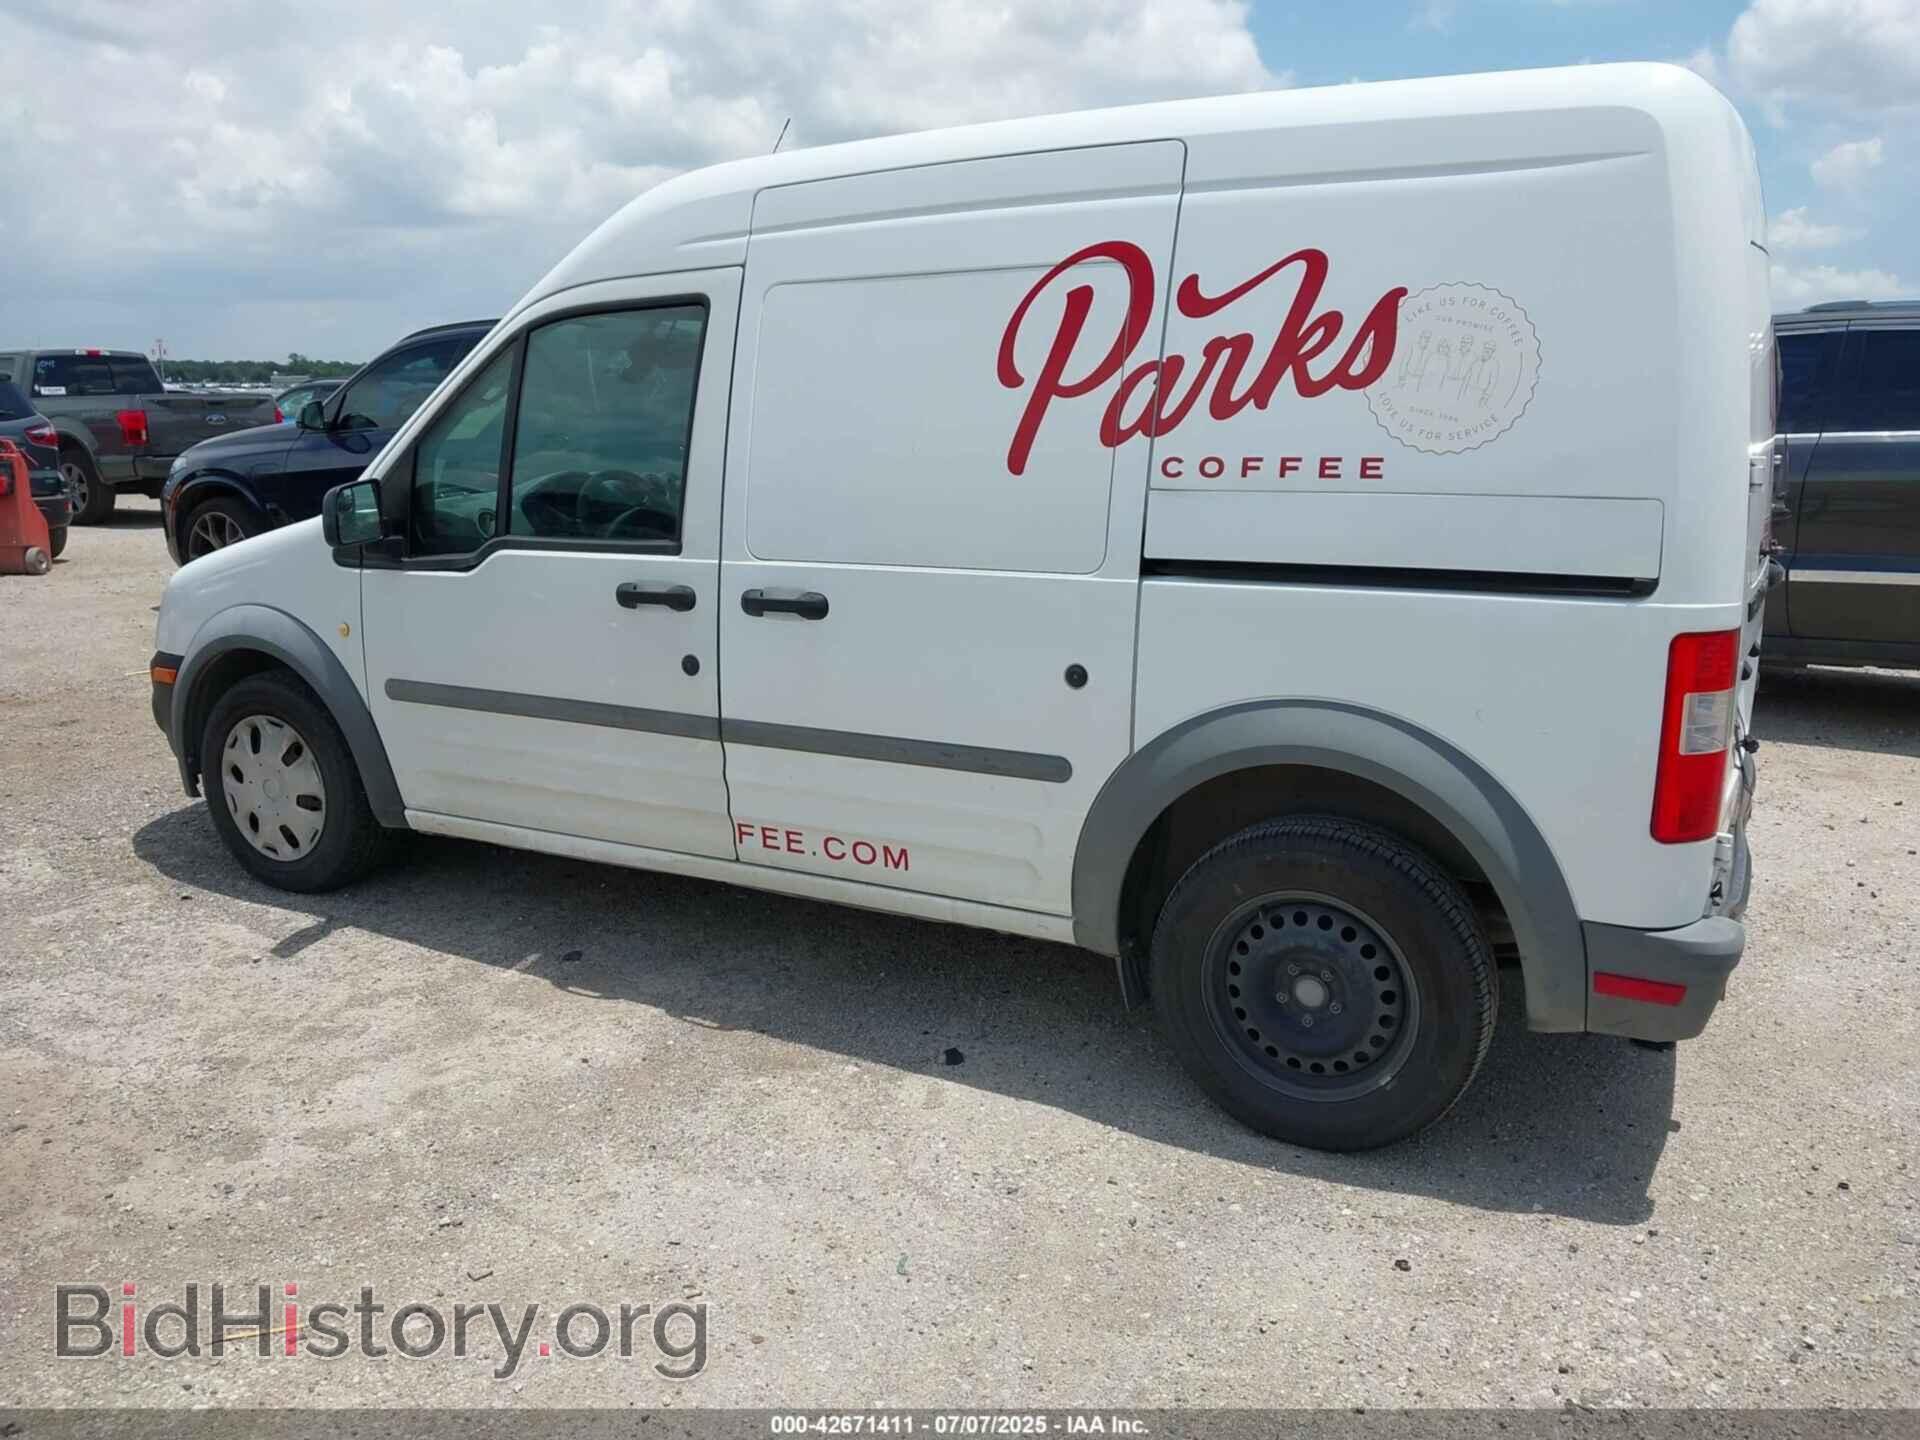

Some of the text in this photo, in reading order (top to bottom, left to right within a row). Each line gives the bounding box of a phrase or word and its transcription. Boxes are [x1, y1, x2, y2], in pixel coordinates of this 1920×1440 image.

[1404, 296, 1523, 346] LIKE US FOR COFFEE
[997, 240, 1409, 476] Parks
[1379, 391, 1398, 419] LOVE
[1399, 417, 1414, 432] US
[1417, 428, 1442, 440] FOR
[1447, 413, 1498, 440] SERVICE
[1160, 456, 1385, 479] COFFEE
[737, 822, 910, 872] FEE.COM
